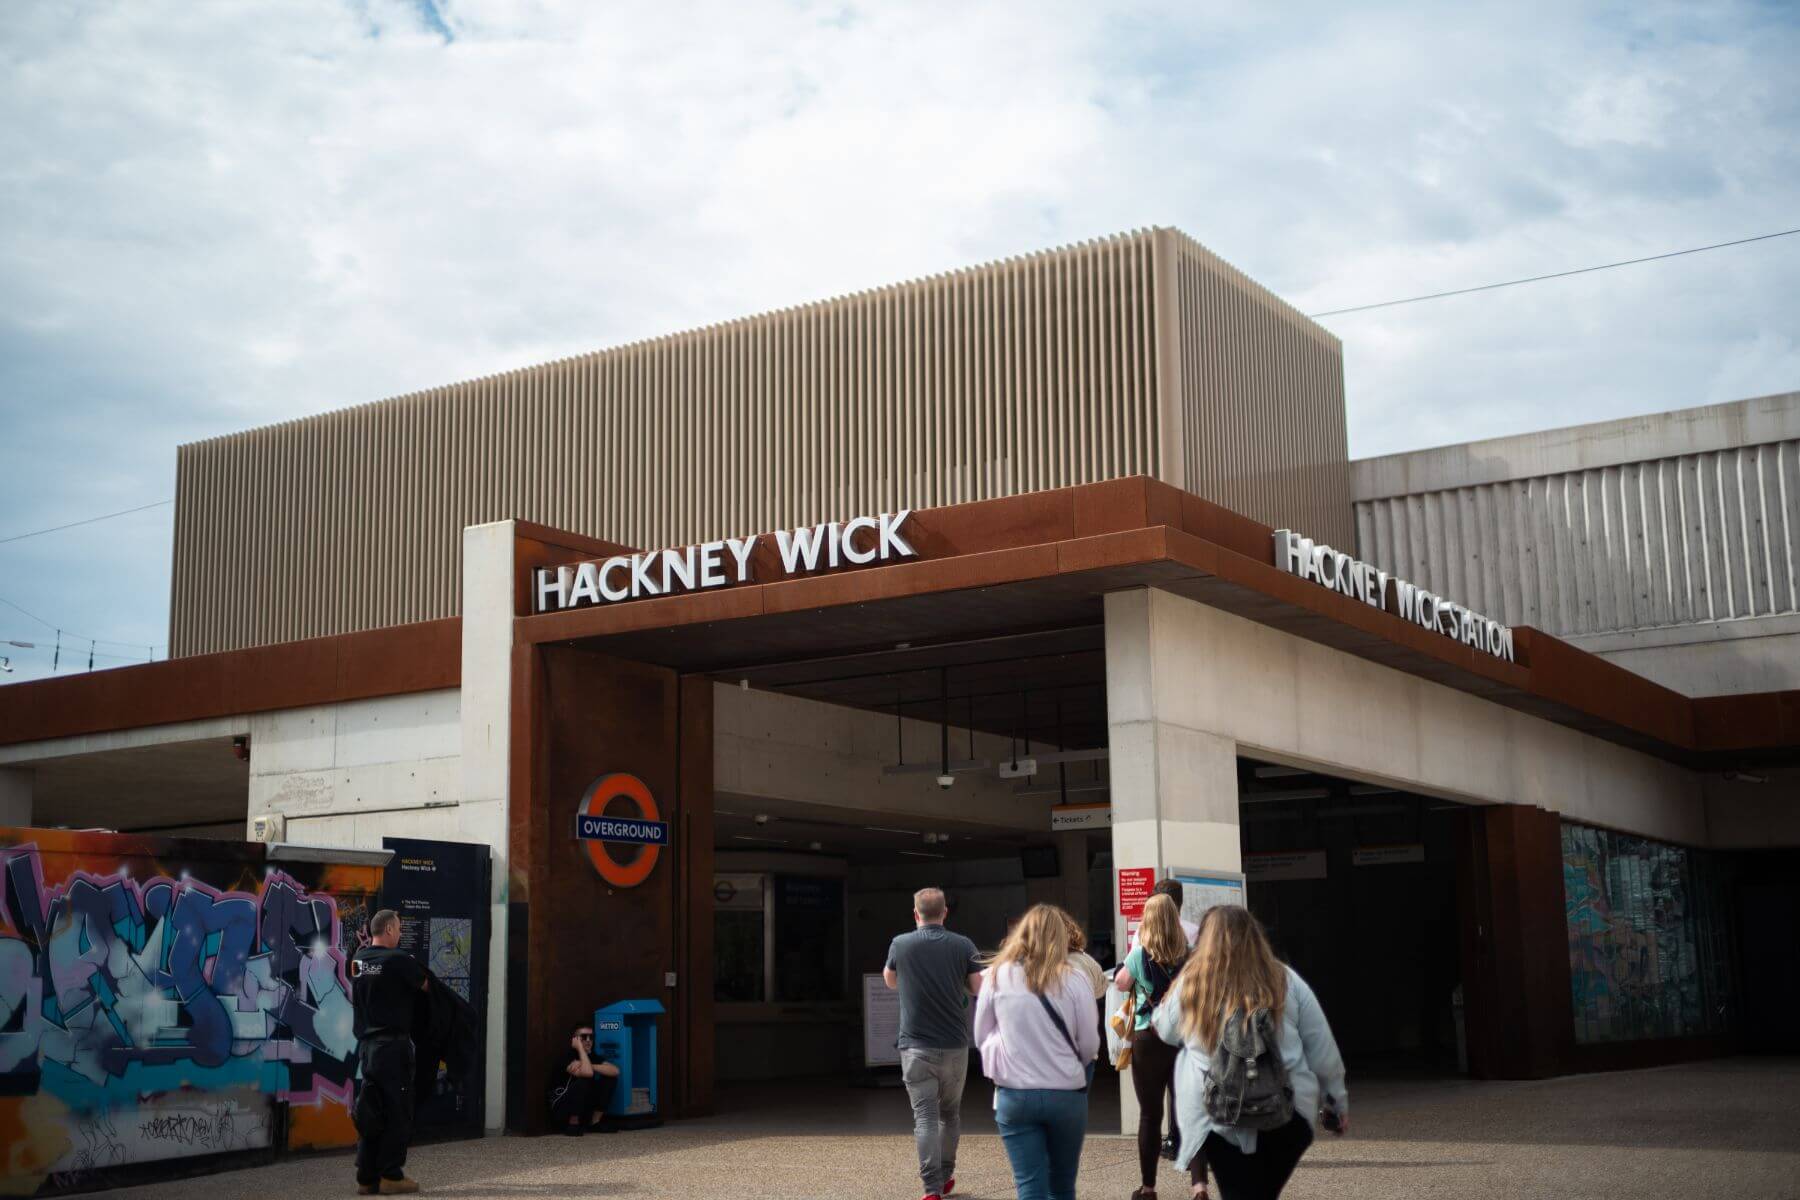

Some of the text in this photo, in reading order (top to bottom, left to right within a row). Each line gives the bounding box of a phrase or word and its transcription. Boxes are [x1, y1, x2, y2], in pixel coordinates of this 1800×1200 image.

[535, 509, 919, 612] HACKNEY WICK
[1274, 529, 1515, 663] HACKNEY WICK STATION
[583, 820, 662, 839] OVERGROUND
[1060, 816, 1084, 824] Tickets
[600, 1022, 619, 1030] METRO
